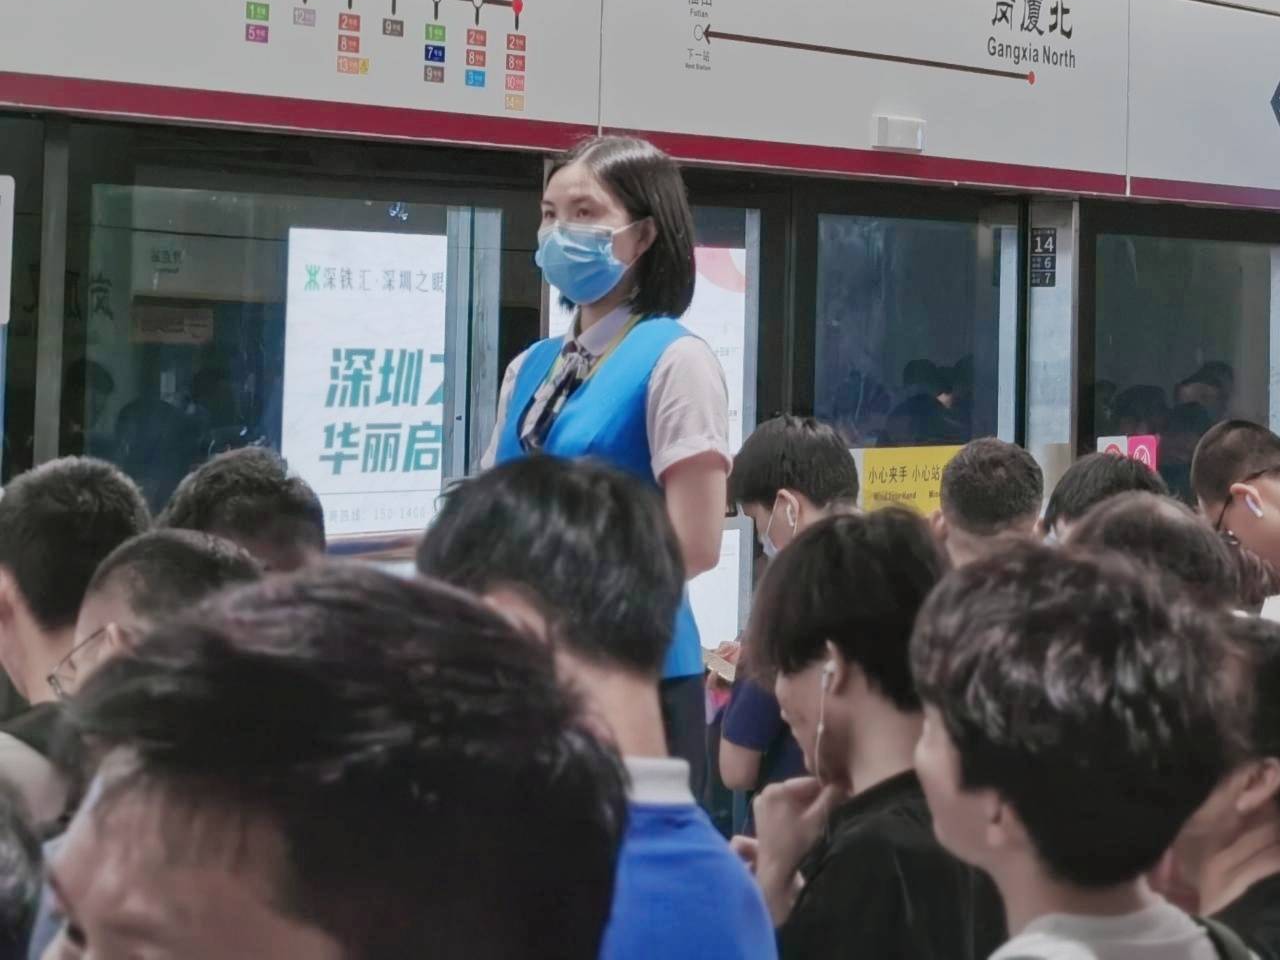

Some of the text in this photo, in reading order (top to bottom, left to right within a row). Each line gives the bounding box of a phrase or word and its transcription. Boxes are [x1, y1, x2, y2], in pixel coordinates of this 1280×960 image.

[987, 36, 1076, 68] Gangxia North
[1034, 236, 1054, 253] 14
[319, 421, 442, 475] 华丽启
[869, 465, 907, 484] 小心夹手
